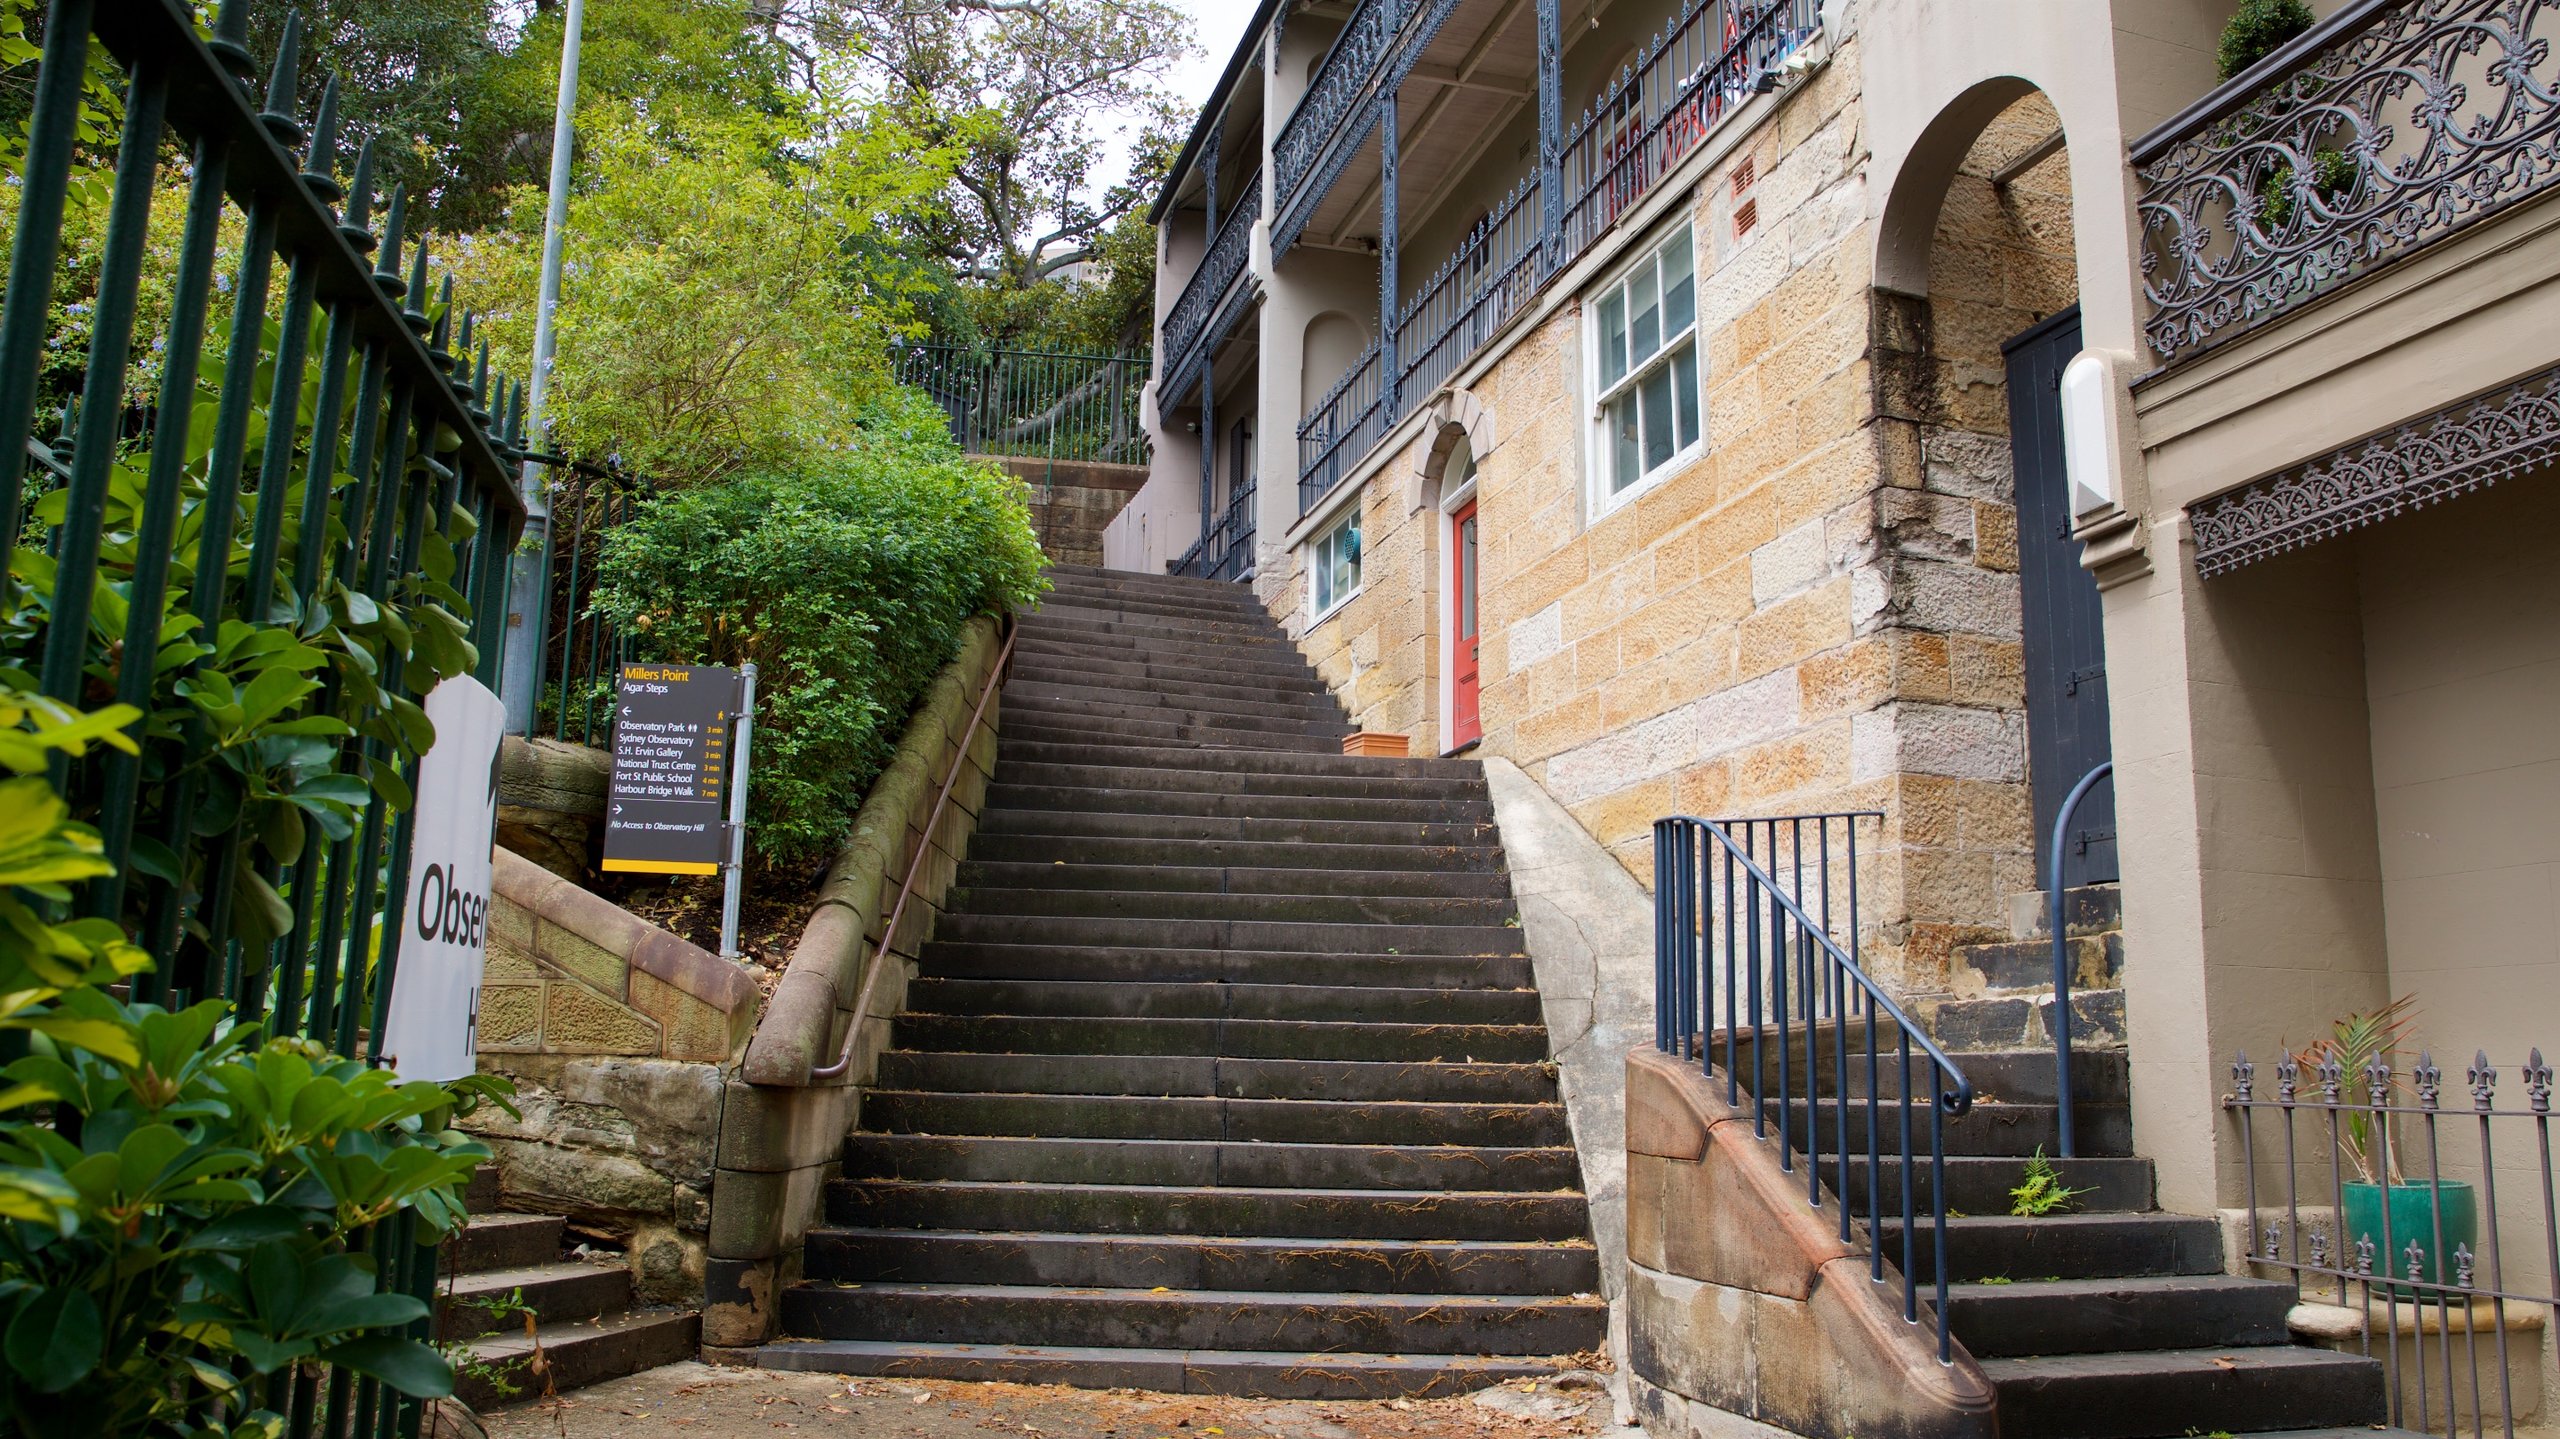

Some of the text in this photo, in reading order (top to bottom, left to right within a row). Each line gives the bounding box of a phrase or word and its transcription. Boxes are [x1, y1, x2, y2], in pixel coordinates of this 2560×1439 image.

[625, 668, 689, 681] Millers Point
[624, 683, 668, 695] Agar Steps
[621, 721, 685, 732] Observatory Park
[619, 734, 694, 746] Sydney Observatory
[618, 747, 683, 759] S.H. Ervin Gallery
[617, 759, 696, 770] National Trust Centre
[616, 772, 693, 783] Fort St Public School
[615, 785, 694, 797] Harbour Bridge Walk
[611, 820, 704, 832] No Access to Observatory Hill
